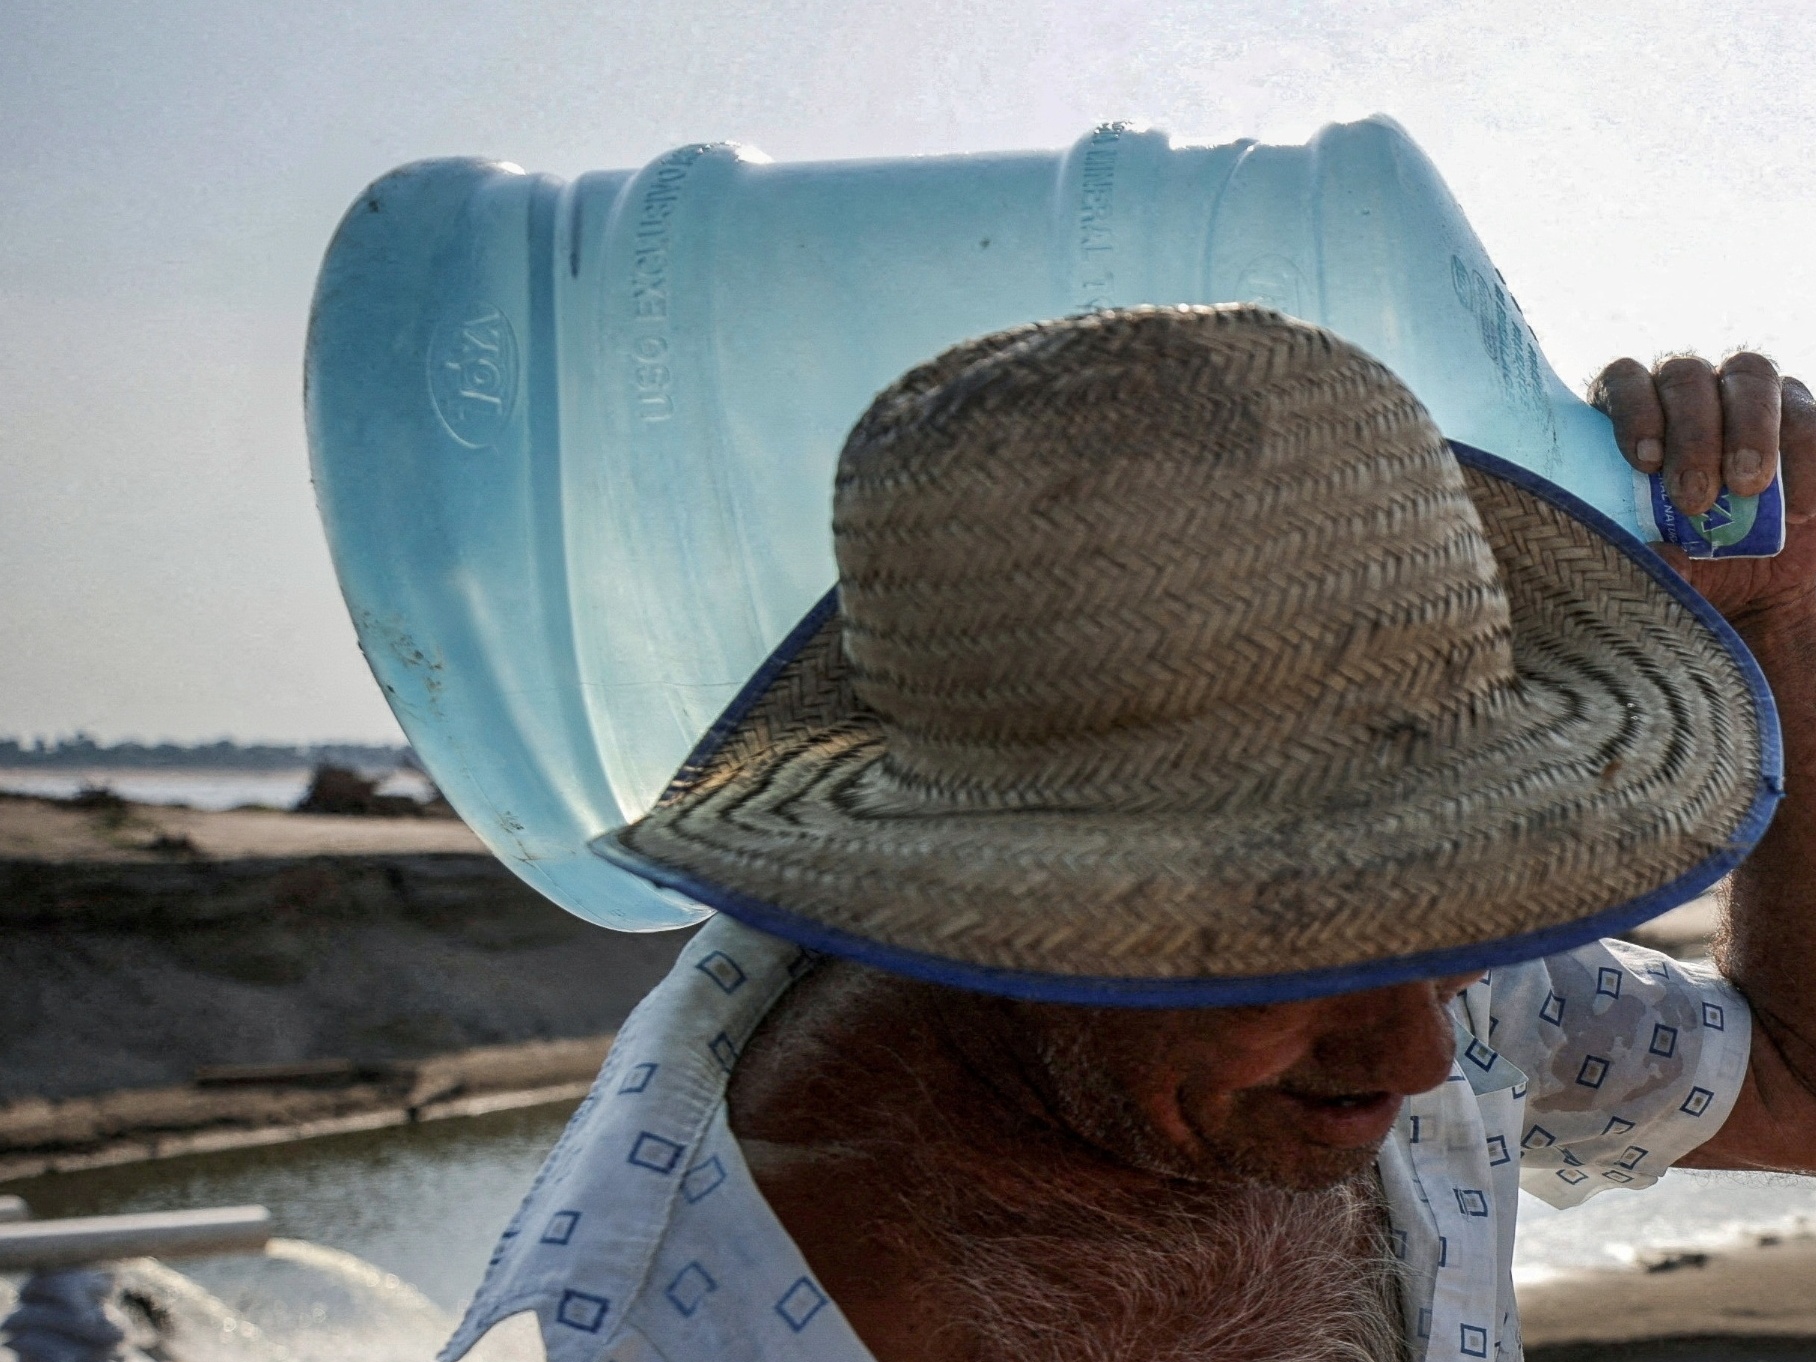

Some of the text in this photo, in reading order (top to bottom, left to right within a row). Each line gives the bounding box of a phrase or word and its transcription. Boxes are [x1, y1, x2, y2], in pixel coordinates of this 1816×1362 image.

[631, 167, 686, 322] EXCLUSIVO
[1080, 149, 1119, 262] MINERAL
[633, 334, 674, 423] USO
